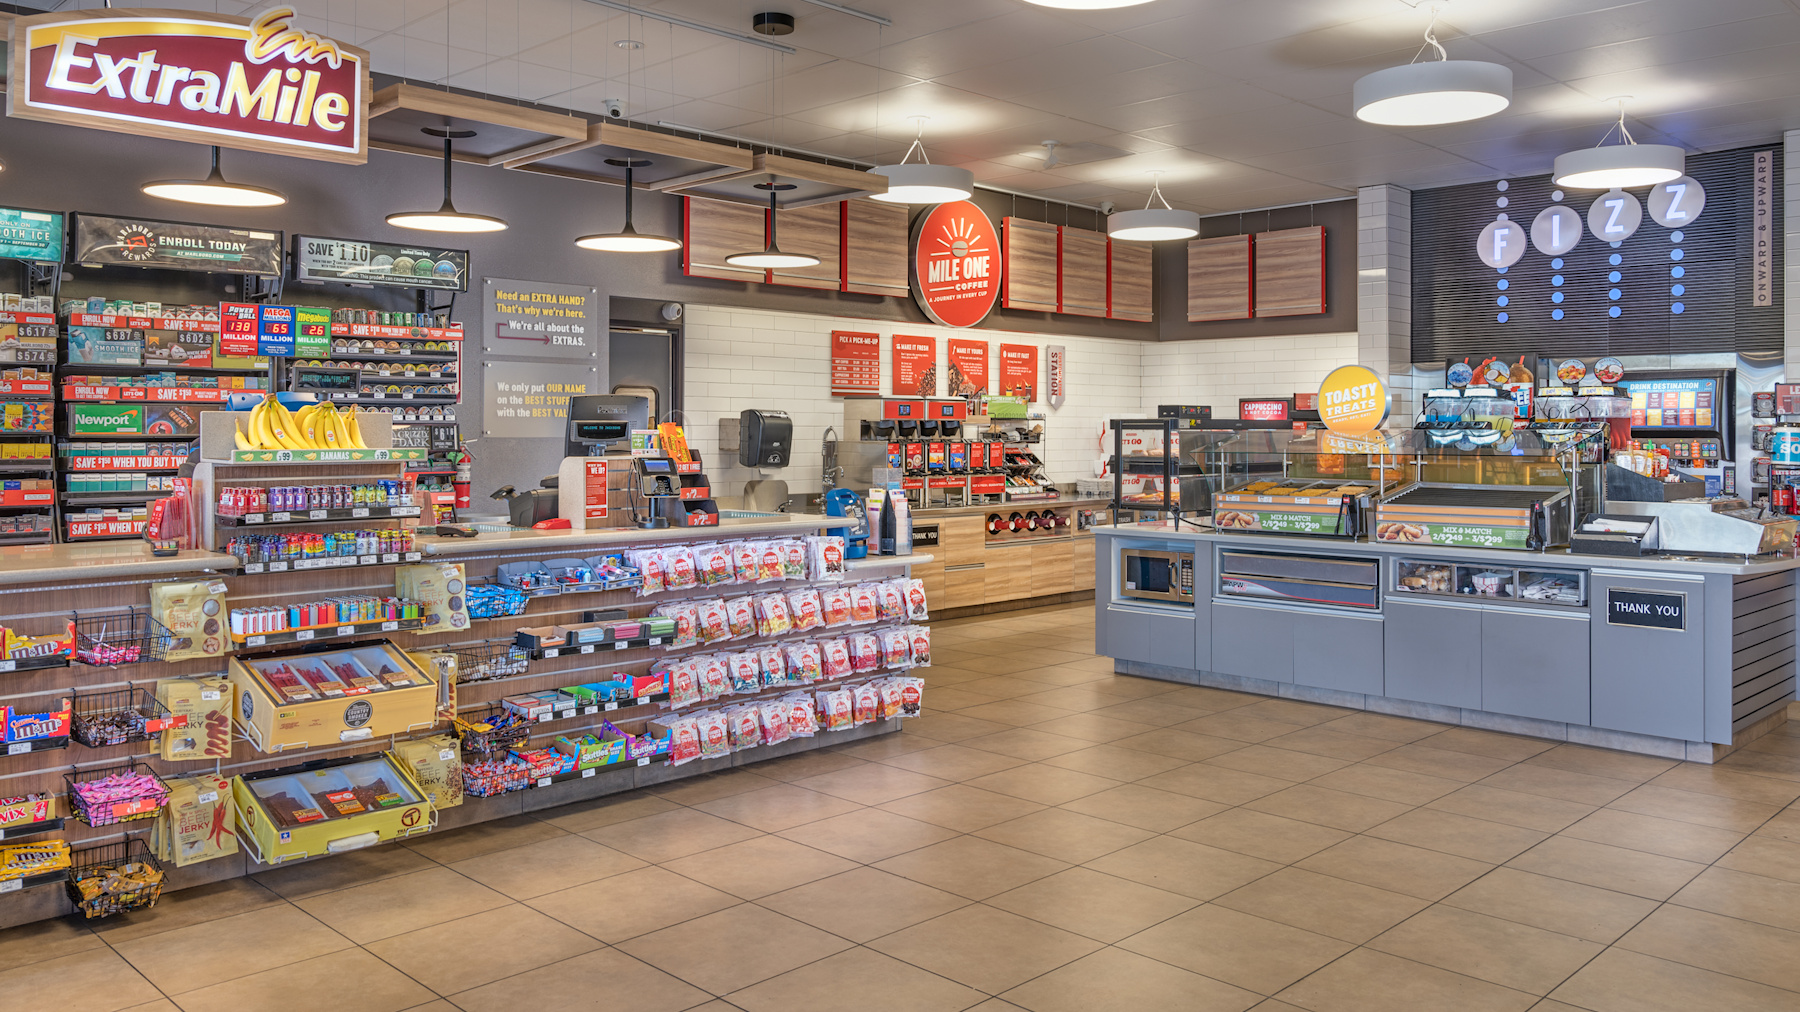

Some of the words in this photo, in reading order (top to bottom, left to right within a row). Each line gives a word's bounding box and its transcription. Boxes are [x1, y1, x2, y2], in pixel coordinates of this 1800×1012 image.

[46, 31, 350, 132] ExtraMile
[1758, 155, 1767, 217] UPWARD
[1758, 223, 1767, 232] &
[31, 231, 51, 241] ICE
[117, 224, 155, 246] MARLBORO
[159, 236, 205, 249] ENROLL
[208, 240, 247, 252] TODAY
[308, 241, 334, 257] SAVE
[121, 242, 157, 261] REWARDS
[928, 258, 960, 283] MILE
[963, 255, 990, 280] ONE
[1758, 238, 1767, 302] ONWARD
[955, 280, 989, 291] COFFEE
[496, 290, 518, 301] Need
[519, 293, 530, 301] an
[531, 292, 558, 304] EXTRA
[559, 295, 586, 306] HAND?
[934, 294, 956, 303] JOURNEY
[238, 312, 256, 320] BALL
[264, 308, 291, 317] MEGA
[496, 303, 523, 314] That's
[524, 306, 541, 318] why
[542, 307, 564, 316] we're
[565, 308, 586, 318] here.
[82, 314, 101, 322] ENROLL
[102, 315, 116, 323] NOW
[164, 320, 184, 331] SAVE
[230, 321, 251, 332] 138
[272, 324, 288, 333] 65
[309, 325, 324, 335] 2.6
[353, 324, 369, 335] SAVE
[509, 320, 532, 331] We're
[534, 322, 545, 331] all
[546, 323, 570, 333] about
[571, 324, 585, 333] the
[221, 333, 257, 342] MILLION
[260, 335, 293, 343] MILLION
[297, 336, 329, 344] MILLION
[552, 335, 586, 346] EXTRAS.
[853, 337, 878, 345] PICK-ME-UP
[95, 345, 126, 353] SMOOTH
[127, 345, 140, 353] ICE
[75, 386, 95, 395] ENROLL
[96, 387, 110, 395] NOW
[497, 382, 510, 391] We
[511, 383, 529, 394] only
[531, 385, 545, 394] put
[546, 383, 563, 393] OUR
[564, 384, 586, 393] NAME
[1630, 383, 1652, 391] DRINK
[1652, 382, 1700, 390] DESTINATION
[158, 389, 178, 400] SAVE
[1324, 382, 1378, 406] TOASTY
[497, 396, 508, 405] on
[510, 395, 523, 405] the
[525, 396, 545, 405] BEST
[497, 407, 516, 417] with
[517, 408, 531, 417] the
[532, 408, 552, 417] BEST
[1244, 403, 1283, 411] CAPPUCCINO
[1325, 399, 1377, 416] TREATS
[75, 414, 130, 427] Newport
[398, 430, 430, 438] GRIZZLY
[400, 438, 430, 447] DARK
[320, 451, 349, 460] BANANAS
[76, 457, 96, 468] SAVE
[113, 457, 136, 467] WHEN
[137, 457, 151, 467] YOU
[154, 456, 169, 467] BUY
[72, 522, 93, 535] SAVE
[108, 521, 132, 533] WHEN
[912, 532, 927, 540] THANK
[927, 531, 938, 539] YOU
[1614, 602, 1651, 615] THANK
[1655, 604, 1680, 617] YOU
[169, 620, 199, 630] JERKY
[582, 748, 609, 763] Skittles
[631, 744, 657, 758] Skittles
[530, 764, 561, 778] Skittles
[179, 811, 210, 827] BEEF
[179, 821, 211, 835] JERKY
